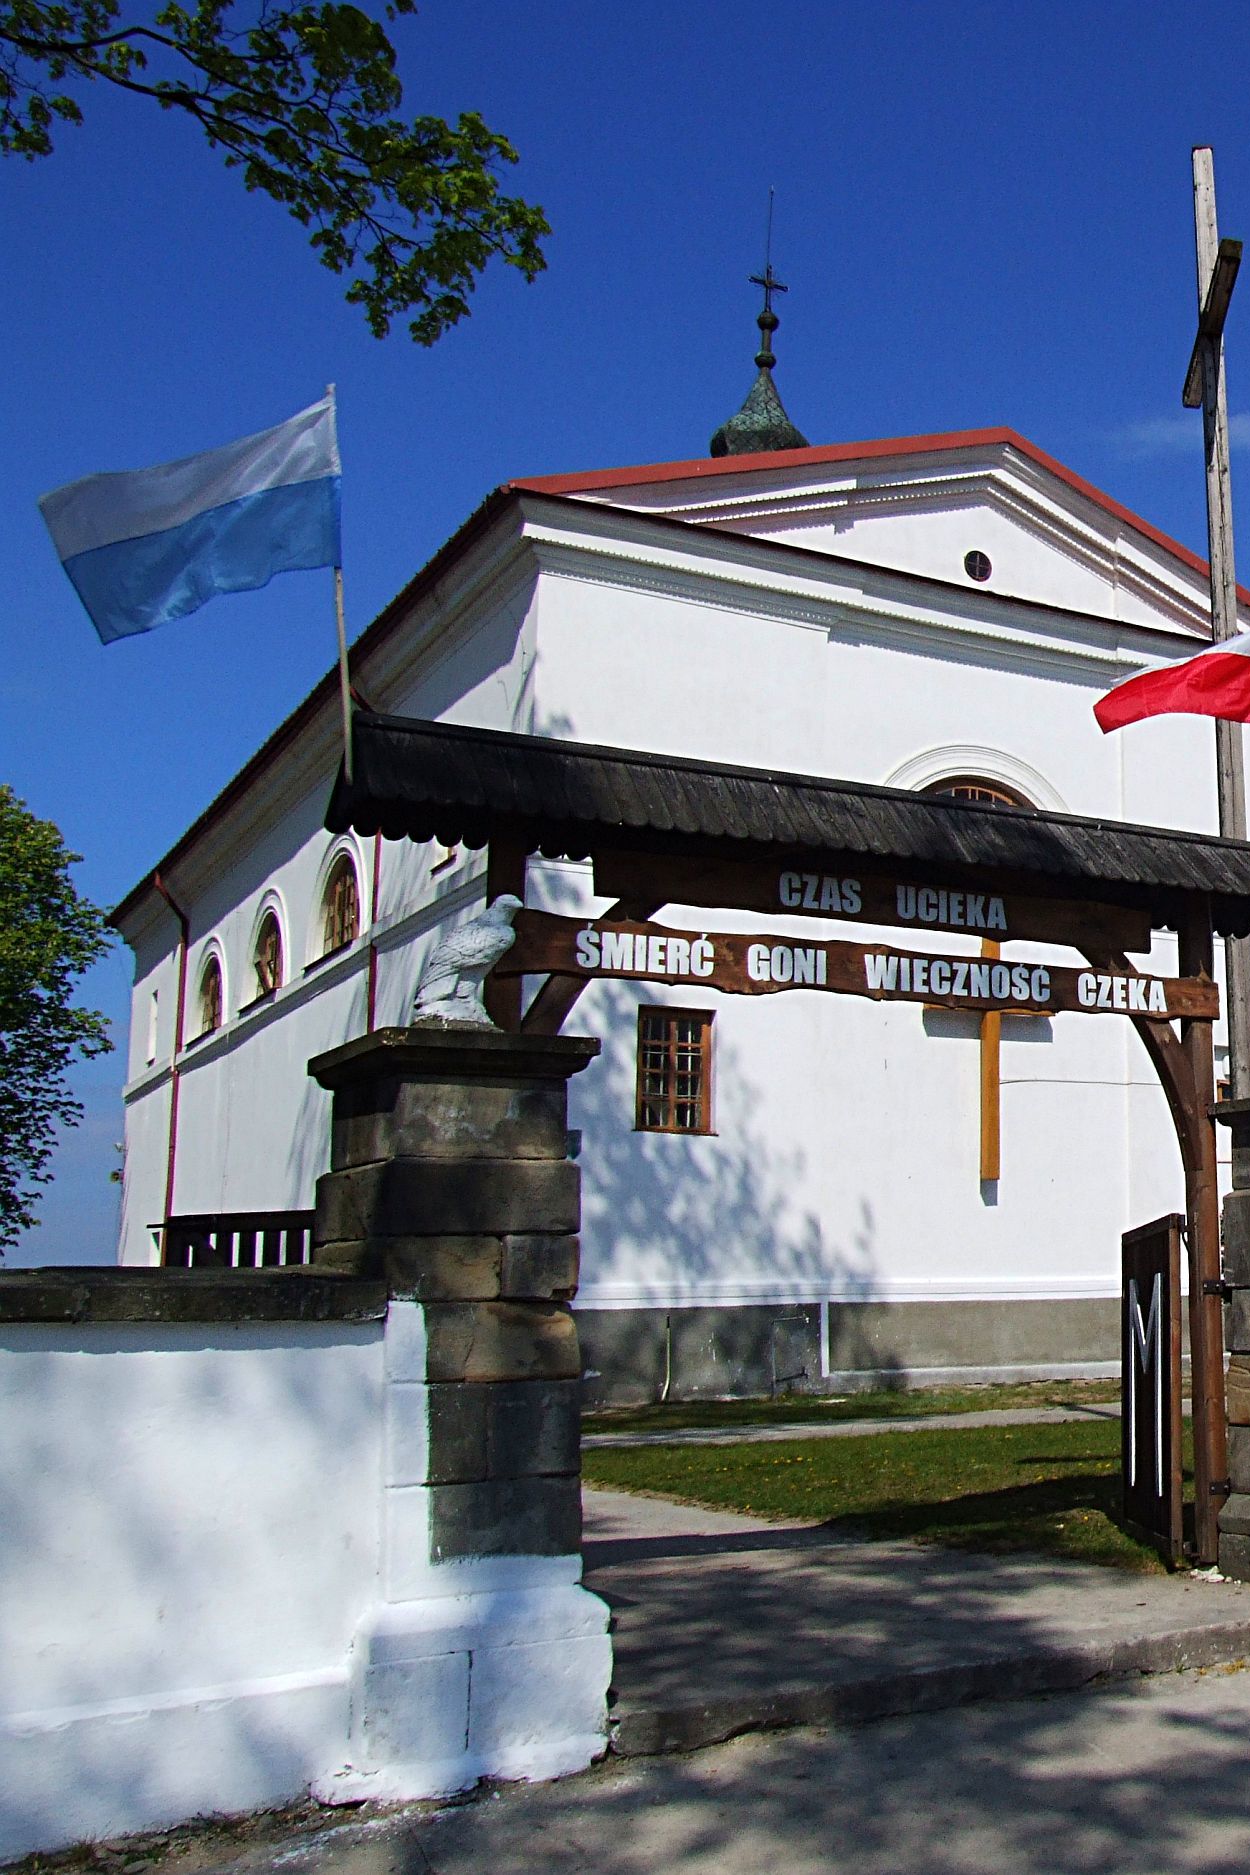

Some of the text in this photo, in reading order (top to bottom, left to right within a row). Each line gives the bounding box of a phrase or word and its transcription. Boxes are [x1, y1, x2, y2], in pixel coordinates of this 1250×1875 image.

[780, 872, 1007, 930] CZAS UCIEKA
[576, 923, 1168, 1012] ŚMIERĆ GONI WIECZNOŚĆ CZEKA
